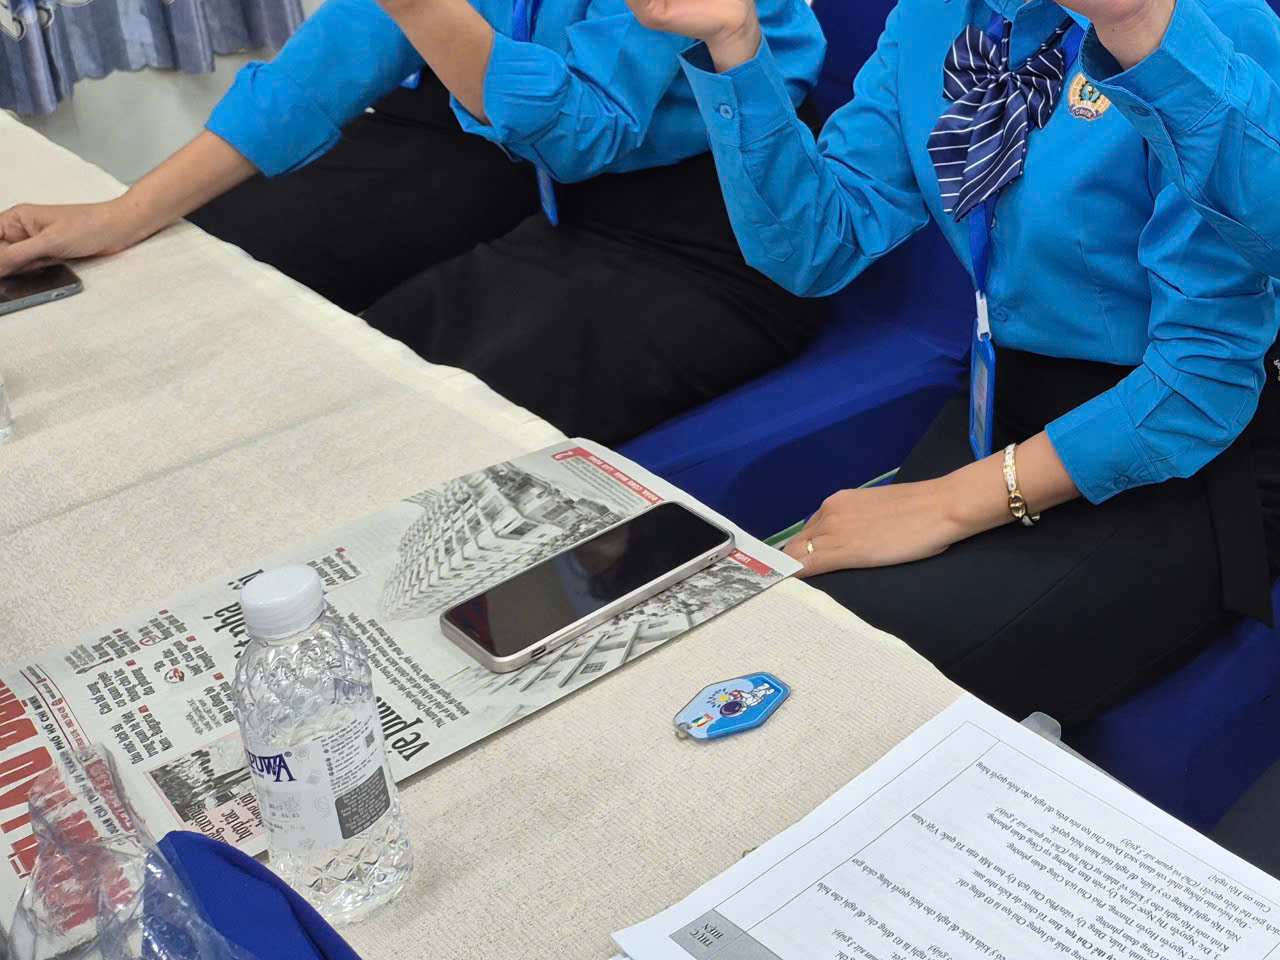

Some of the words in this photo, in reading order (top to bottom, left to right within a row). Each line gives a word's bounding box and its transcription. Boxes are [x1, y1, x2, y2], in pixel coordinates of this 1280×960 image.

[27, 694, 43, 711] MINH
[34, 709, 50, 723] CHÍ
[41, 722, 57, 735] HỒ
[47, 734, 66, 751] PHỐ
[218, 808, 240, 826] tác
